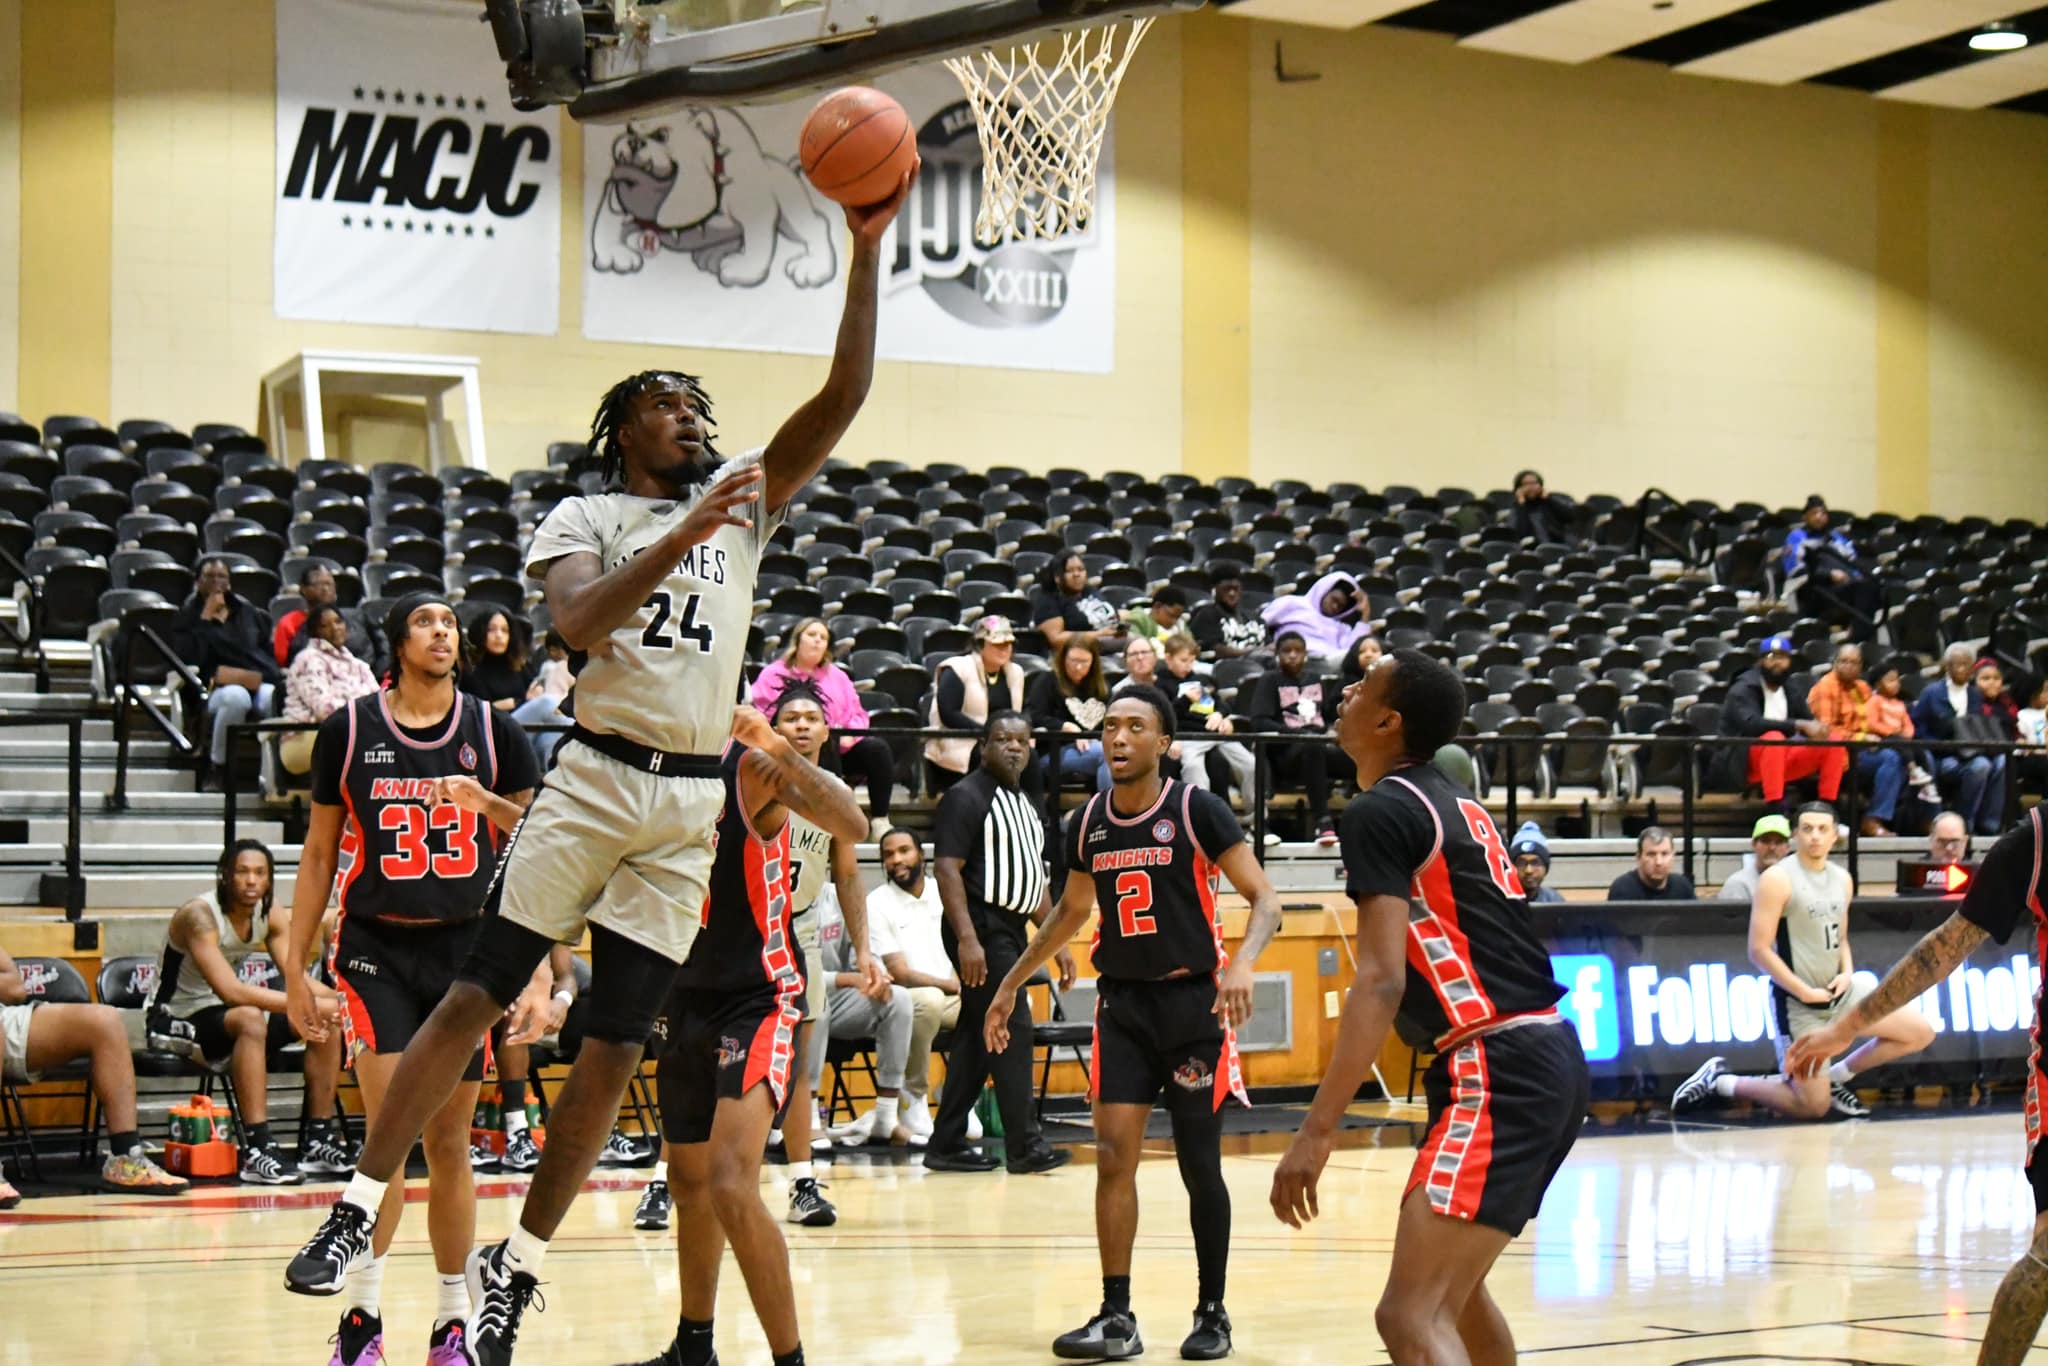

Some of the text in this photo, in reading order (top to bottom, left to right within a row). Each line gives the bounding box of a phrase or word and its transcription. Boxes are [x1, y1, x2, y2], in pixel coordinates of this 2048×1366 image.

[283, 106, 551, 218] MACJC
[983, 267, 1063, 308] XXIII
[640, 591, 714, 653] 24
[364, 751, 395, 764] ELITE
[649, 751, 664, 772] H
[379, 803, 478, 880] 33
[789, 827, 830, 855] LMES
[1092, 847, 1173, 873] KNIGHTS
[1115, 870, 1158, 937] 2
[1948, 954, 2042, 1032] hol
